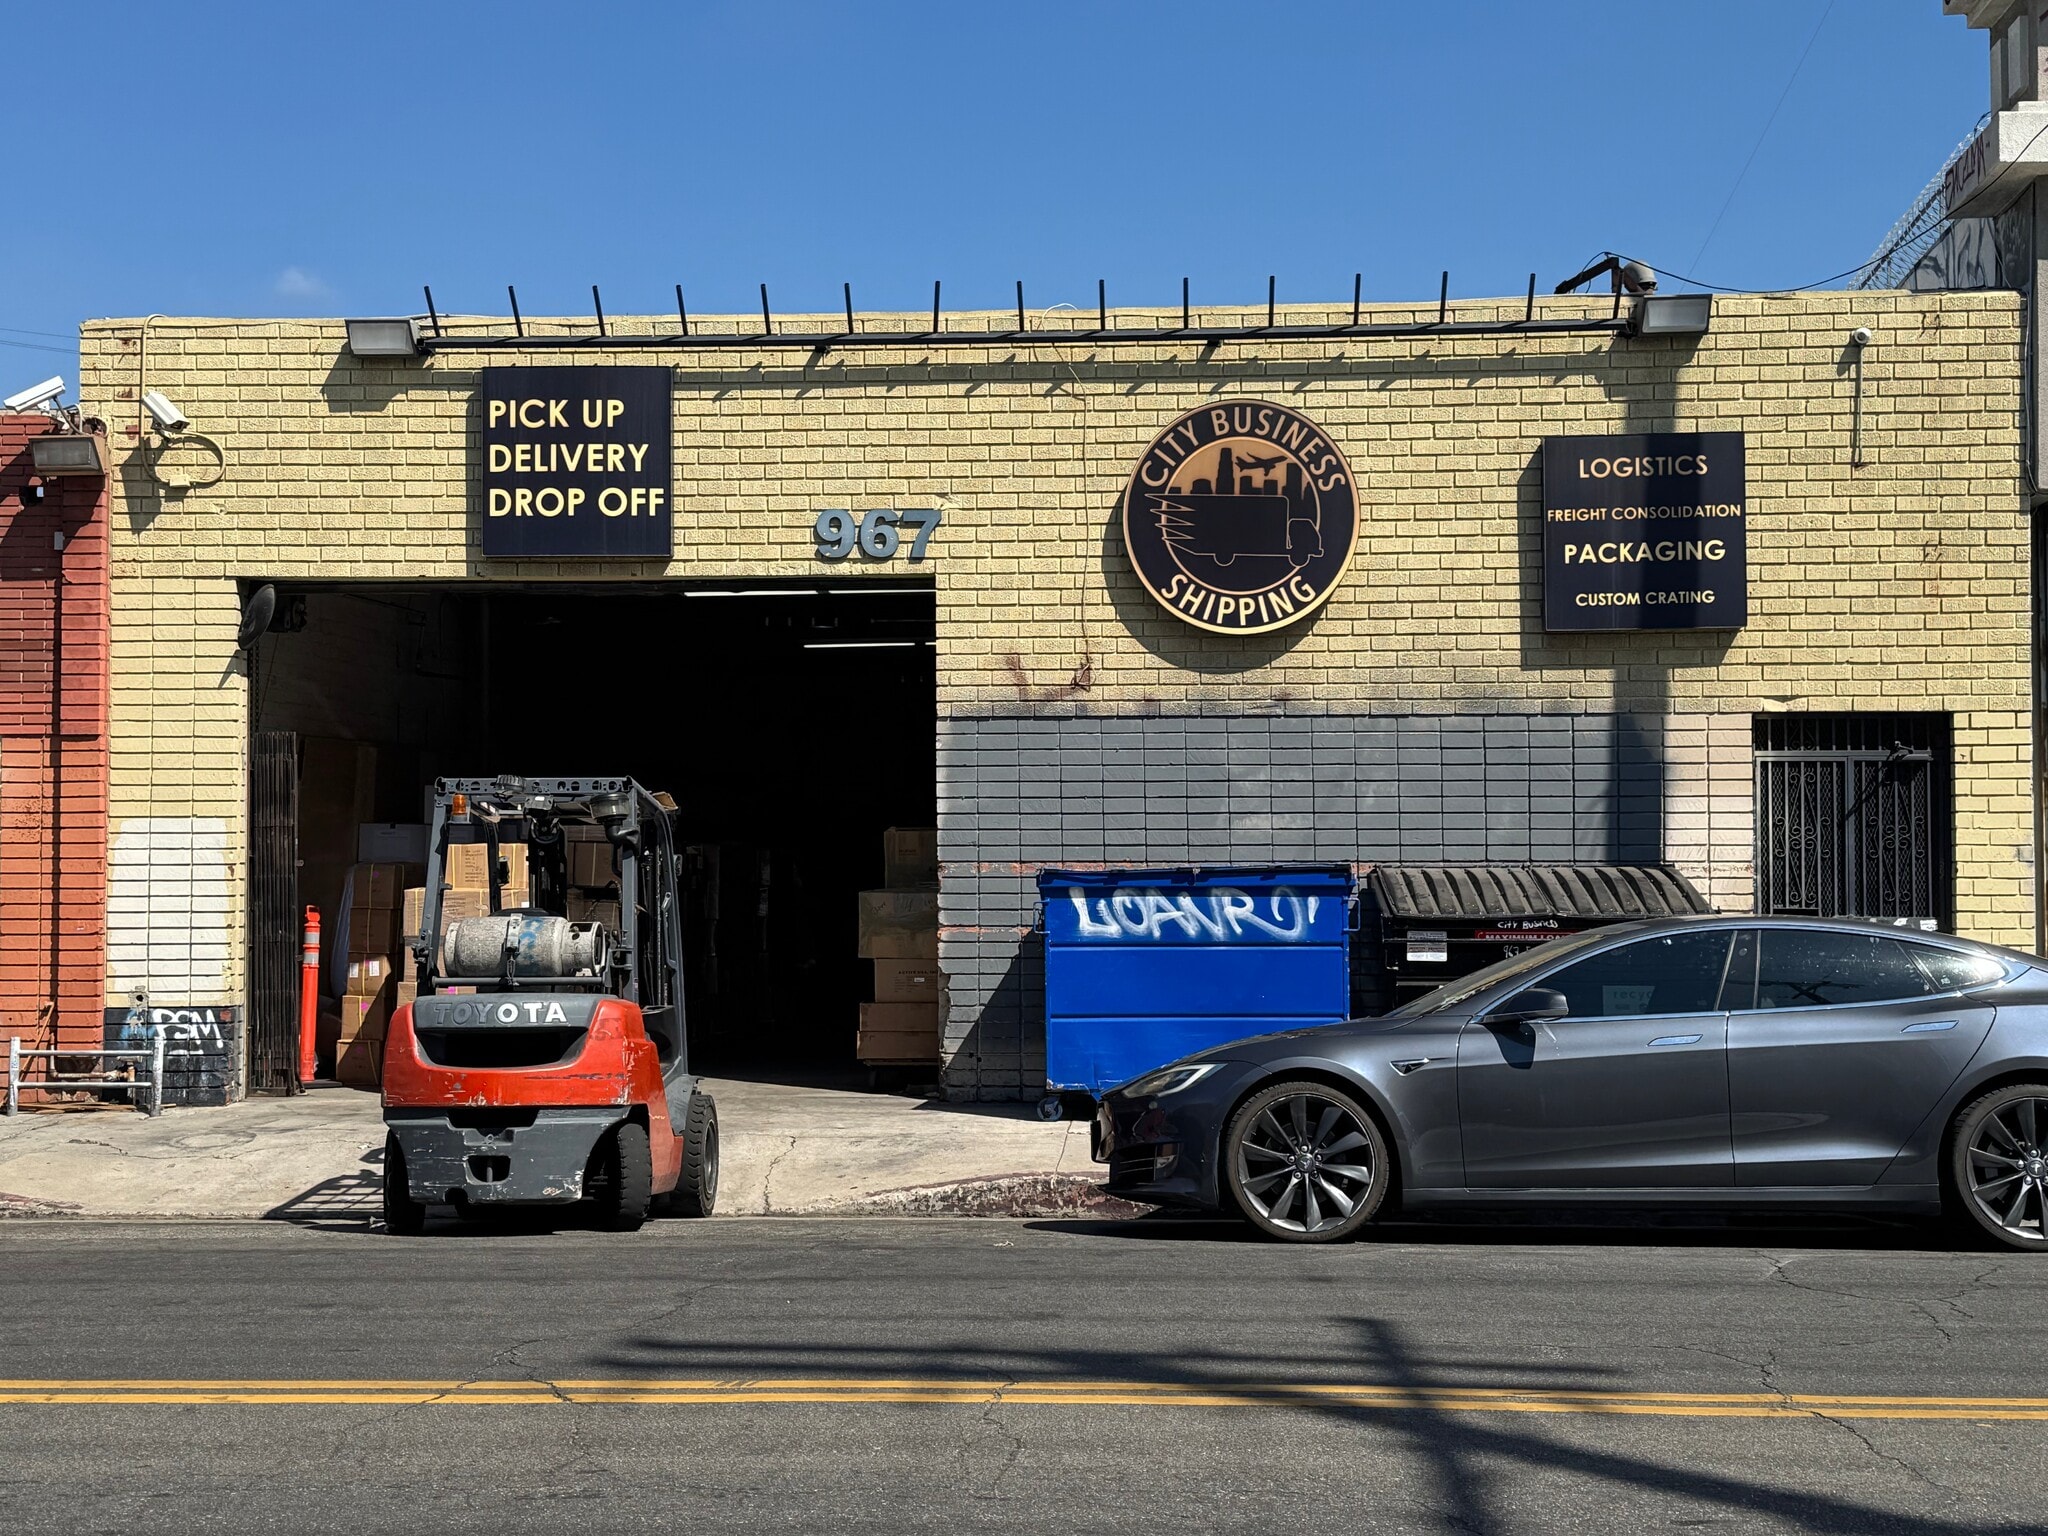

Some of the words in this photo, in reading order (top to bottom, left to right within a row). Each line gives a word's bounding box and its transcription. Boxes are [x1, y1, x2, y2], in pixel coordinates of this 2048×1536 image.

[490, 399, 569, 428] PICK
[583, 400, 624, 427] UP
[490, 444, 648, 472] DELIVERY
[1140, 418, 1200, 488] CITY
[1211, 406, 1346, 492] BUSINESS
[1579, 454, 1708, 479] LOGISTICS
[490, 488, 585, 516] DROP
[599, 488, 664, 516] OFF
[1547, 508, 1606, 522] FREIGHT
[1611, 503, 1741, 519] CONSOLIDATION
[816, 509, 942, 558] 967
[1564, 539, 1726, 563] PACKAGING
[1161, 574, 1315, 626] SHIPPING
[1575, 592, 1640, 606] CUSTOM
[1645, 589, 1714, 605] CRATING
[434, 1001, 567, 1025] TOYOTA
